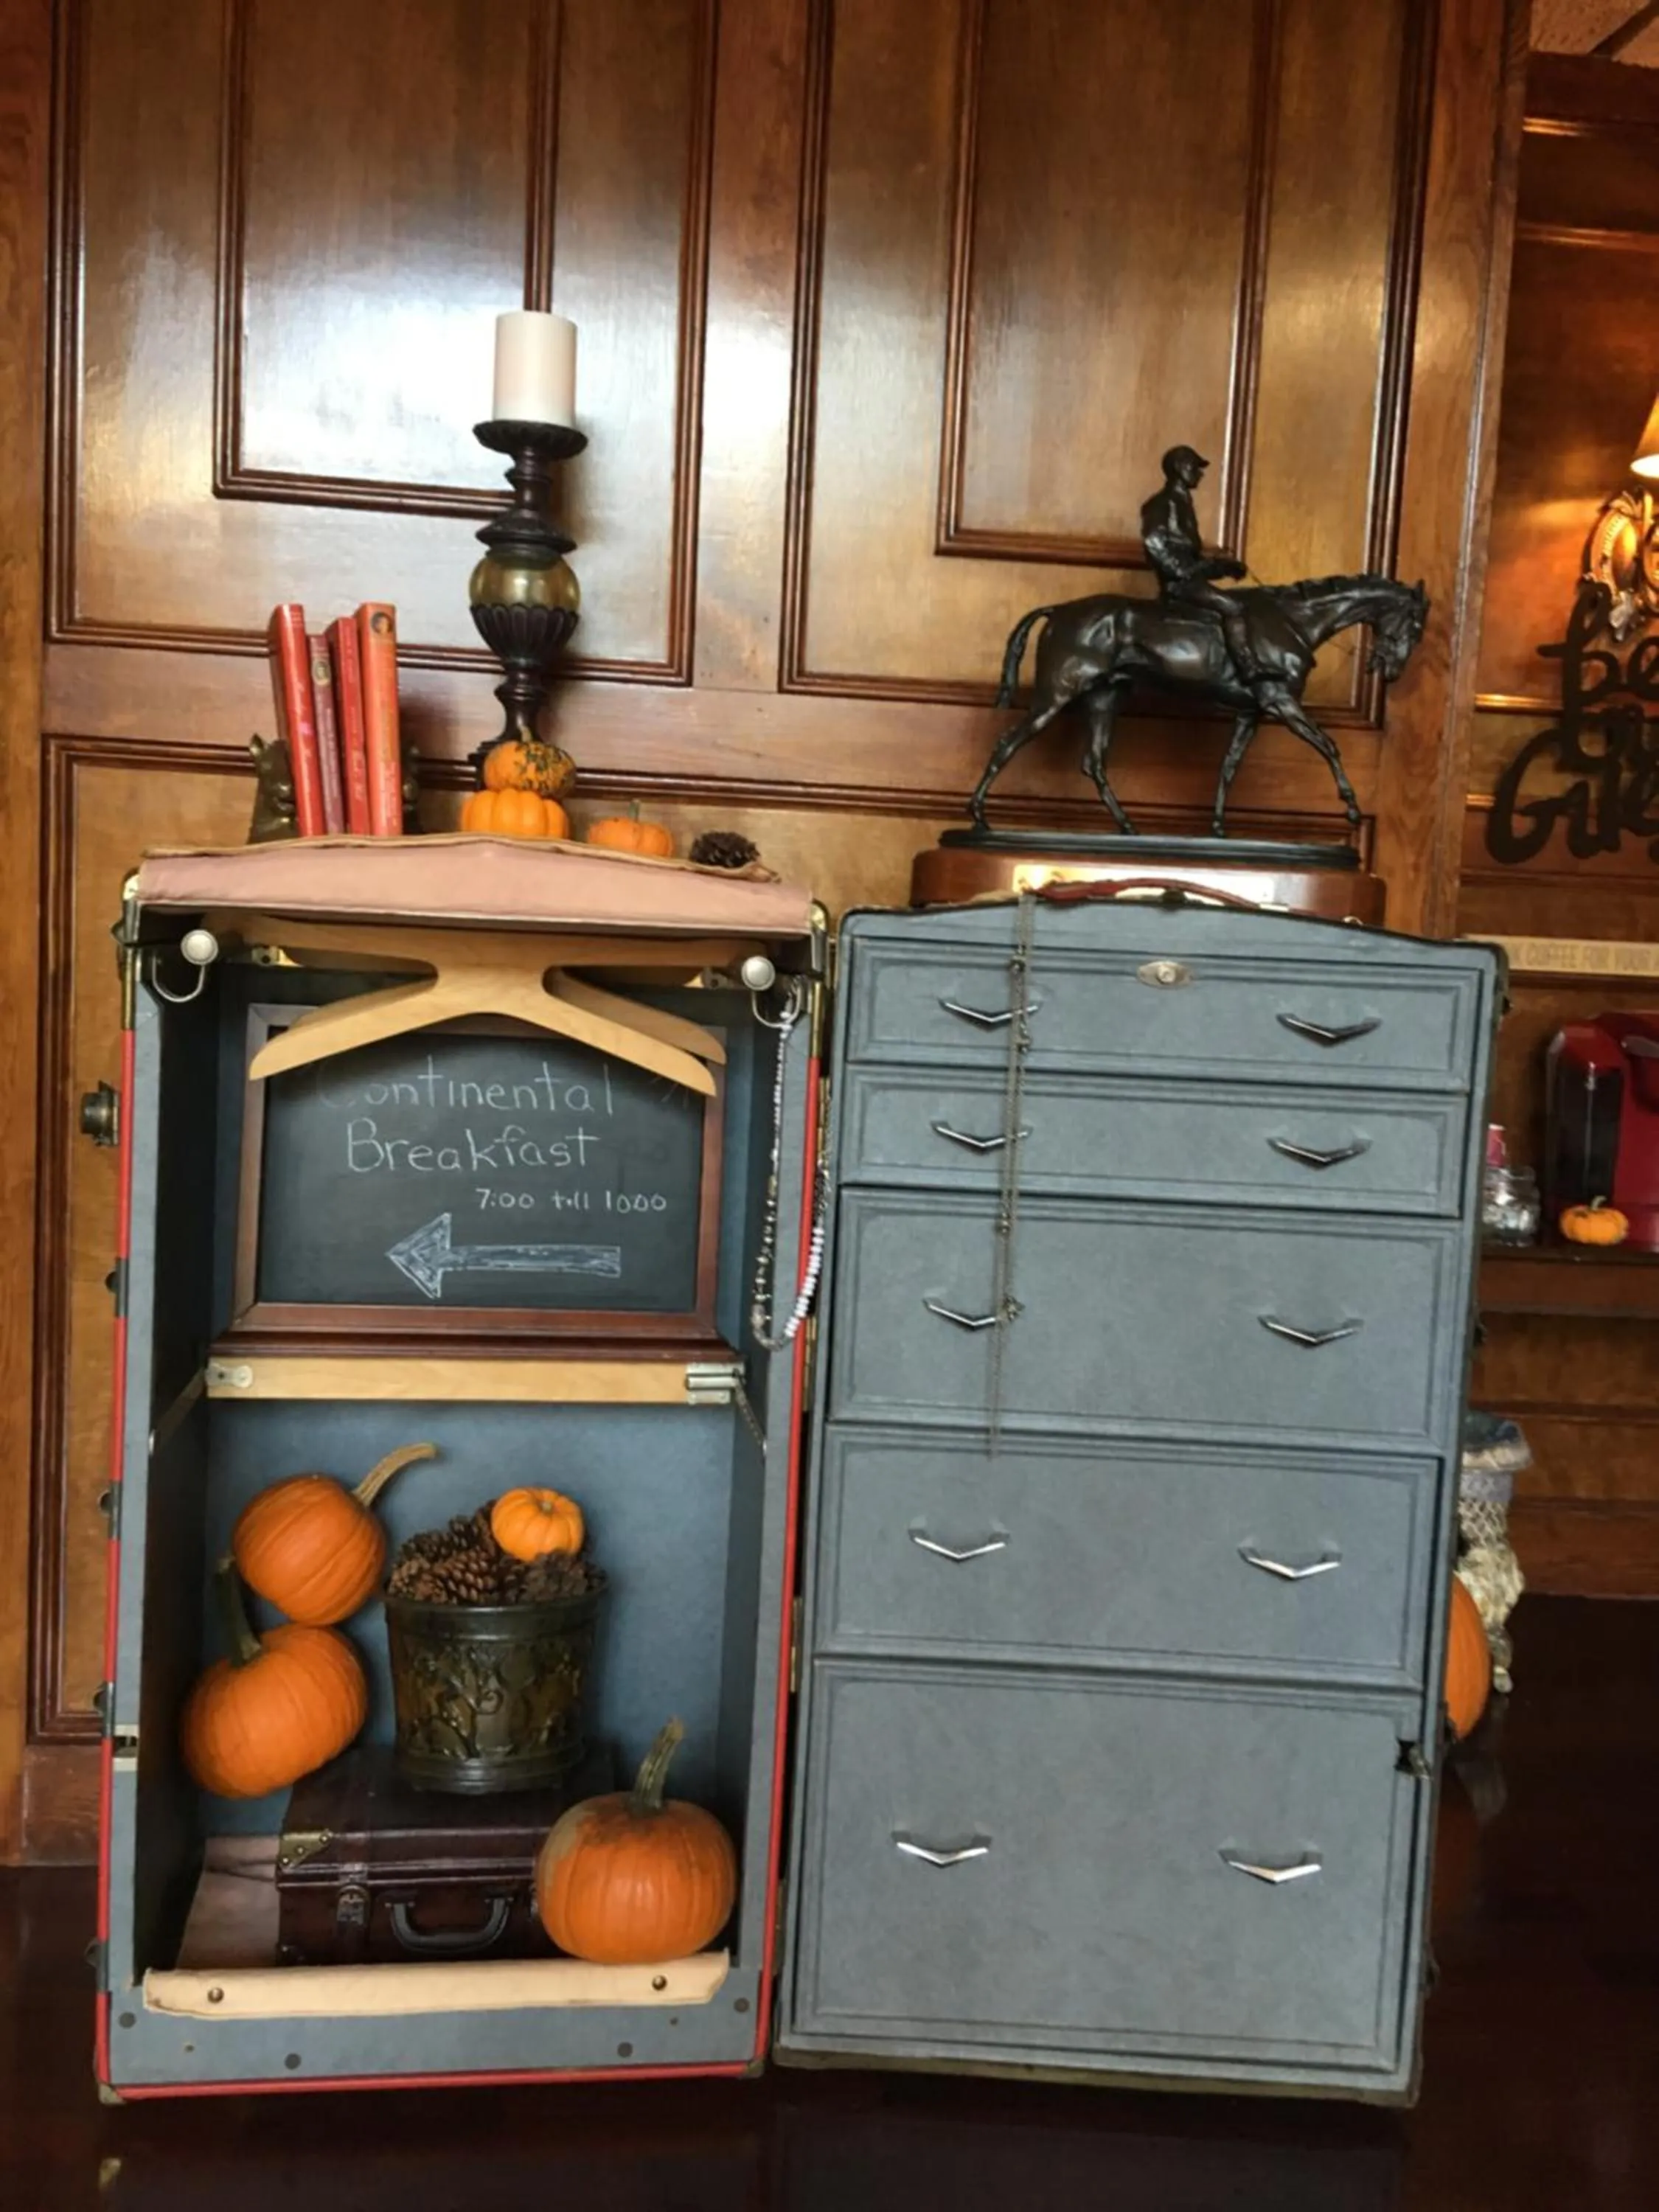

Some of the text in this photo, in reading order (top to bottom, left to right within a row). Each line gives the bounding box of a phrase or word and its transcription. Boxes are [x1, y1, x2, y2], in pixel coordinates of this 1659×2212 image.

[317, 1054, 613, 1116] Continental
[347, 1116, 600, 1173] Breakfast
[476, 1188, 535, 1210] 7:00
